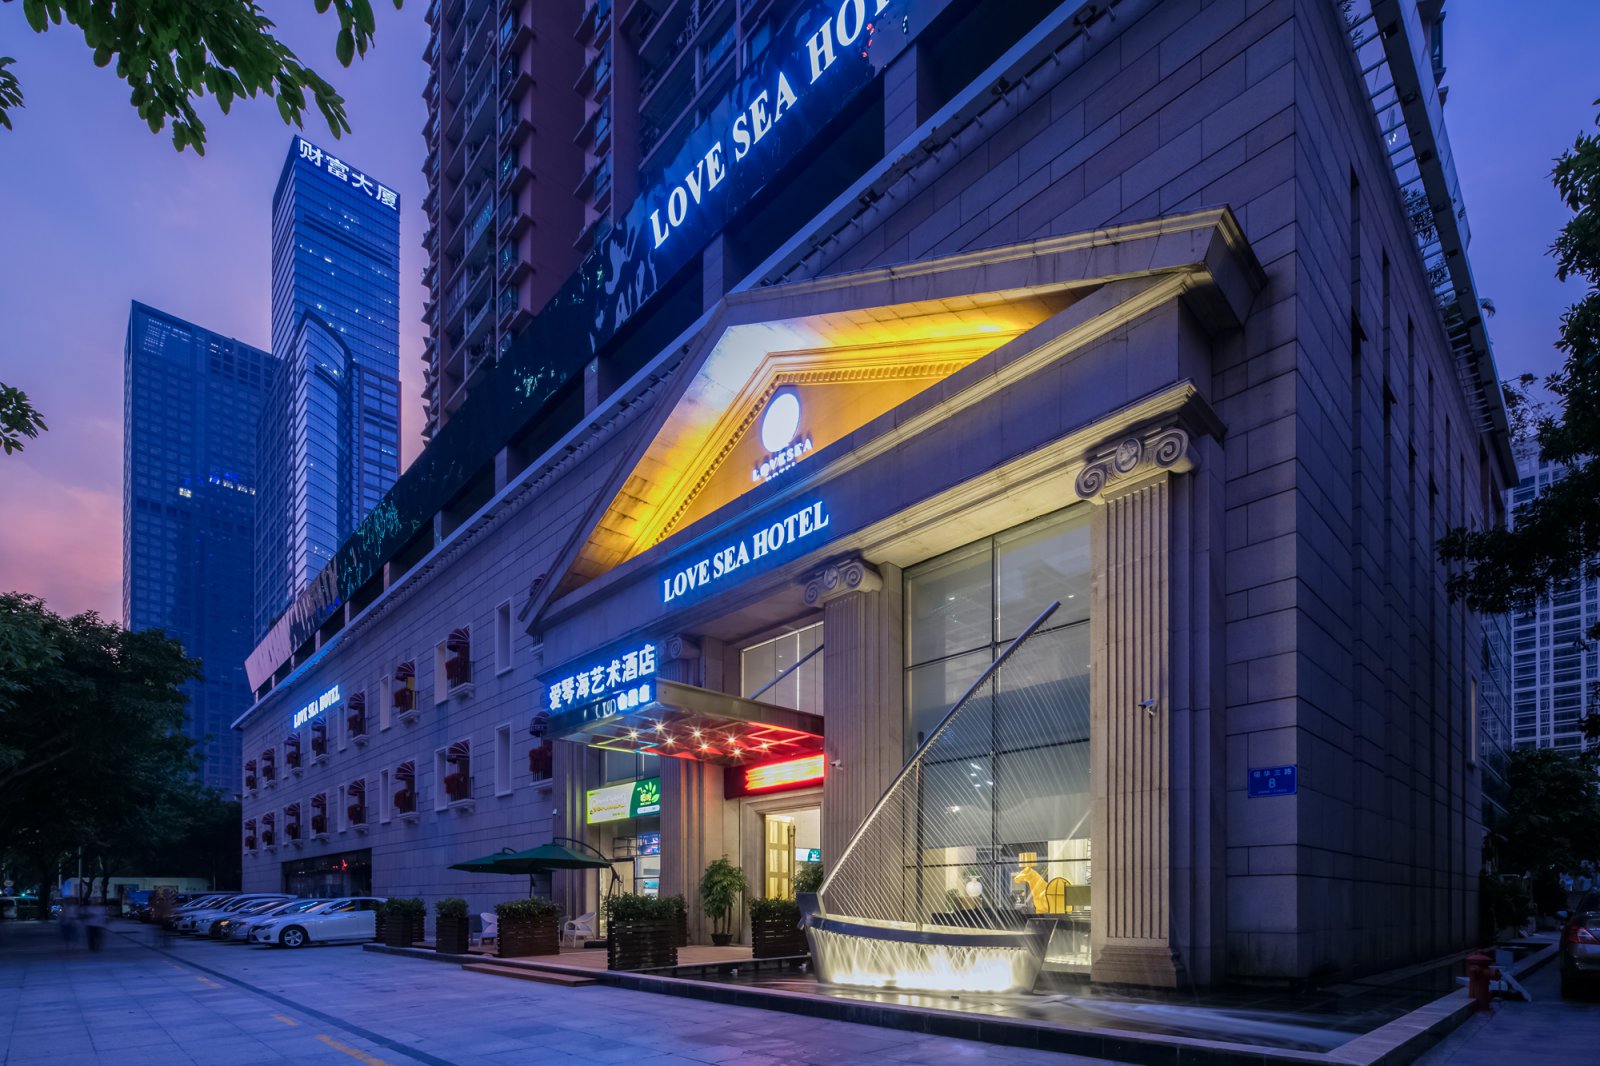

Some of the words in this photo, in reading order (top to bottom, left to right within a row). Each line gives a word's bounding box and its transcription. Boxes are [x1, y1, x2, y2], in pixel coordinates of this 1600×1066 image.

[300, 139, 398, 211] 财富大厦
[650, 141, 726, 249] LOVE
[732, 71, 797, 162] SEA
[664, 559, 710, 602] LOVE
[713, 541, 750, 579] SEA
[752, 501, 829, 560] HOTEL
[549, 644, 655, 711] 爱琴海艺术酒店
[1268, 778, 1276, 788] 8
